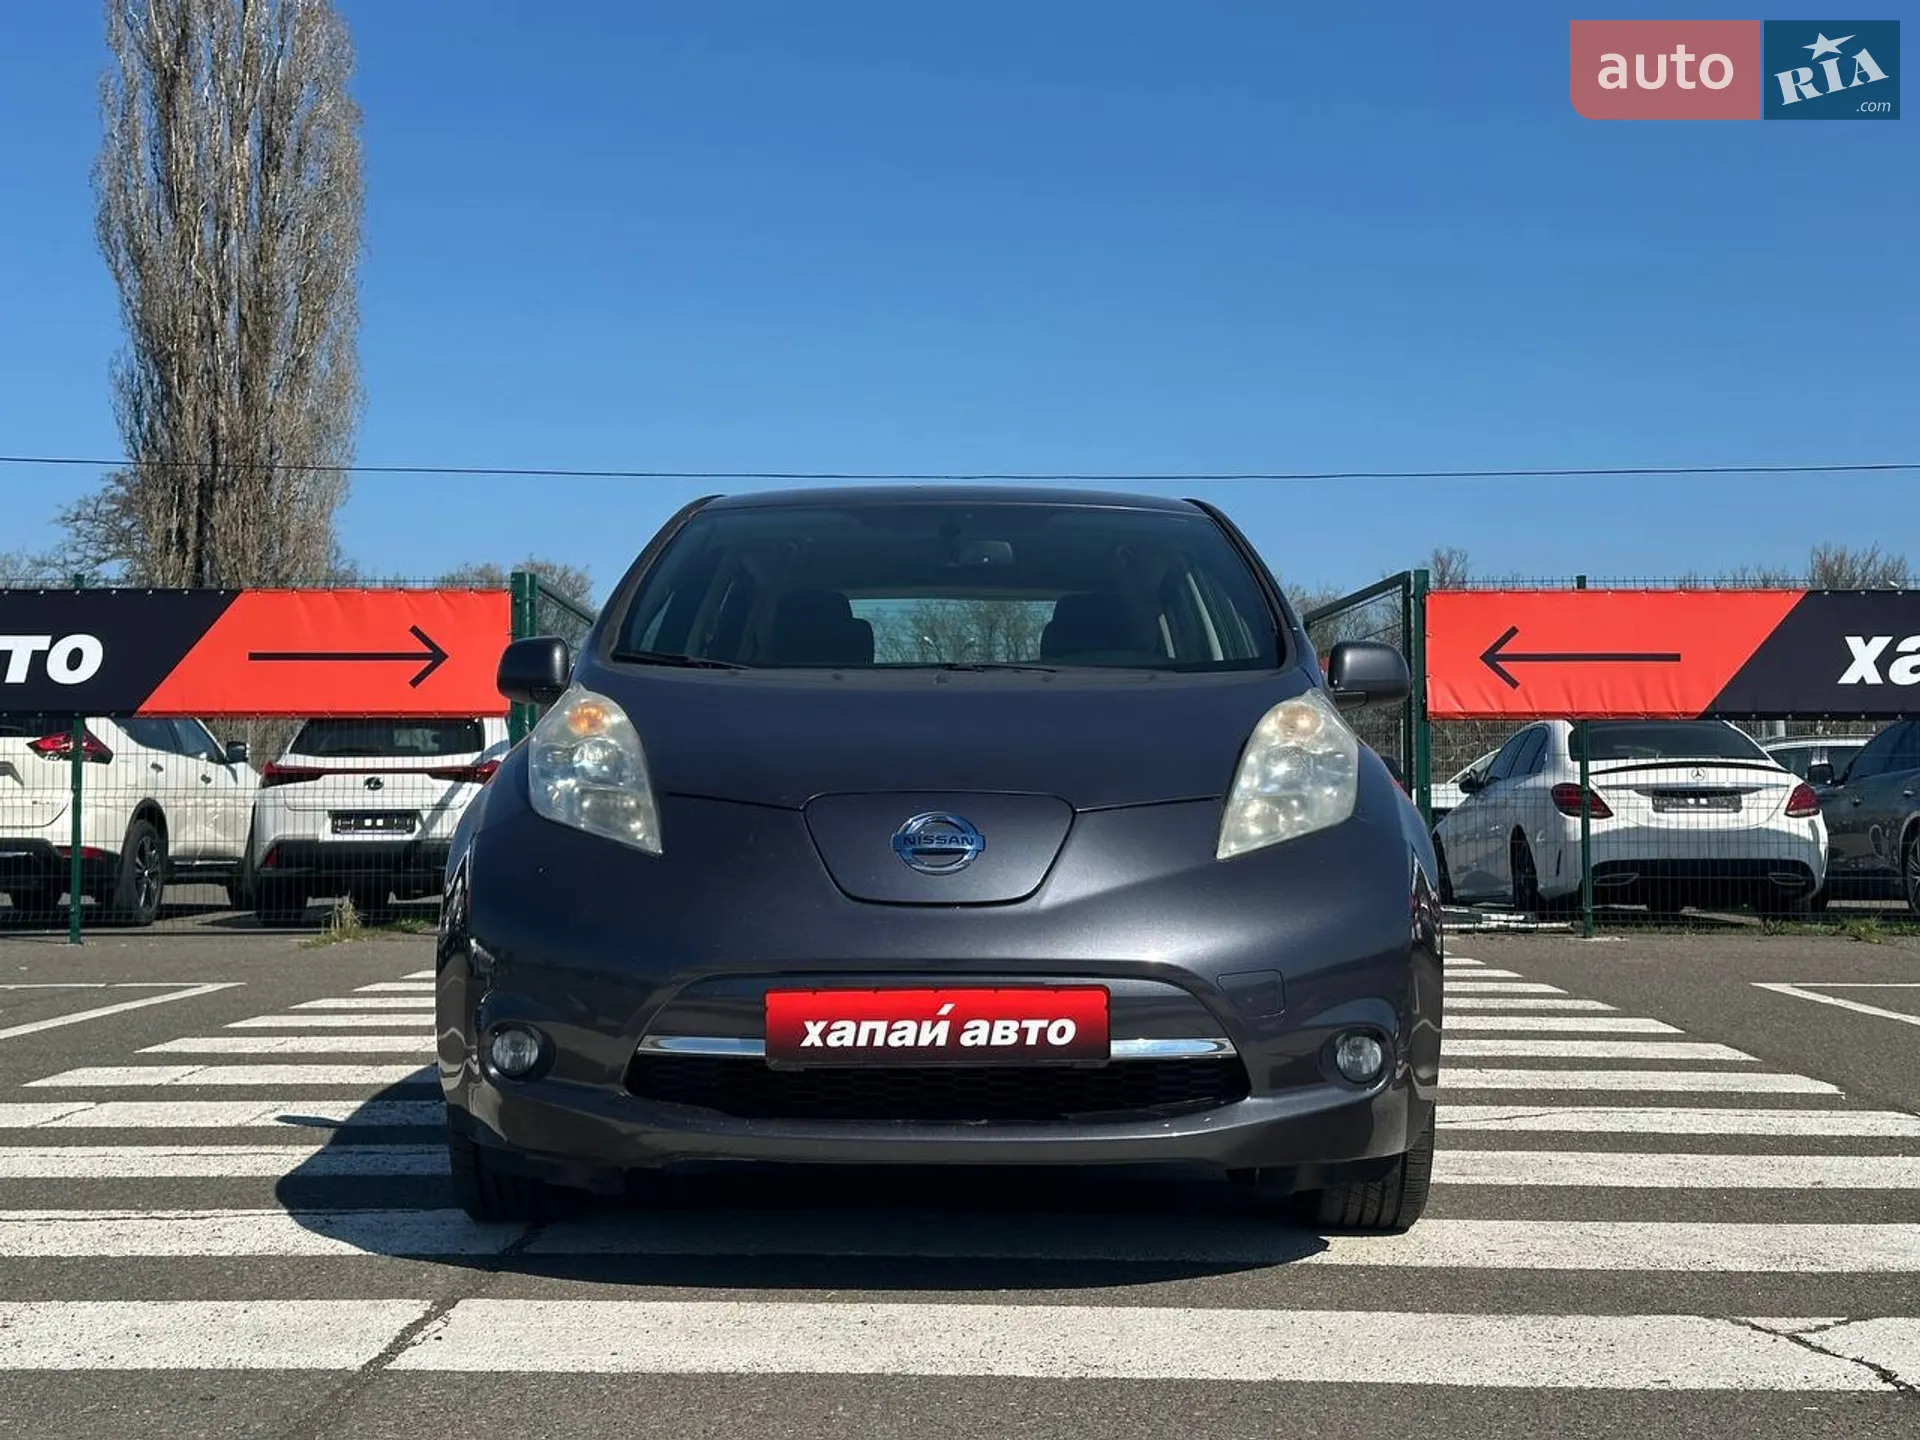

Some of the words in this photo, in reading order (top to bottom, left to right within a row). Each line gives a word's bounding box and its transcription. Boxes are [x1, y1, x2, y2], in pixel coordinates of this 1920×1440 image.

[902, 834, 975, 847] NISSAN
[800, 1003, 955, 1048] хапай
[959, 1018, 1078, 1047] авто
